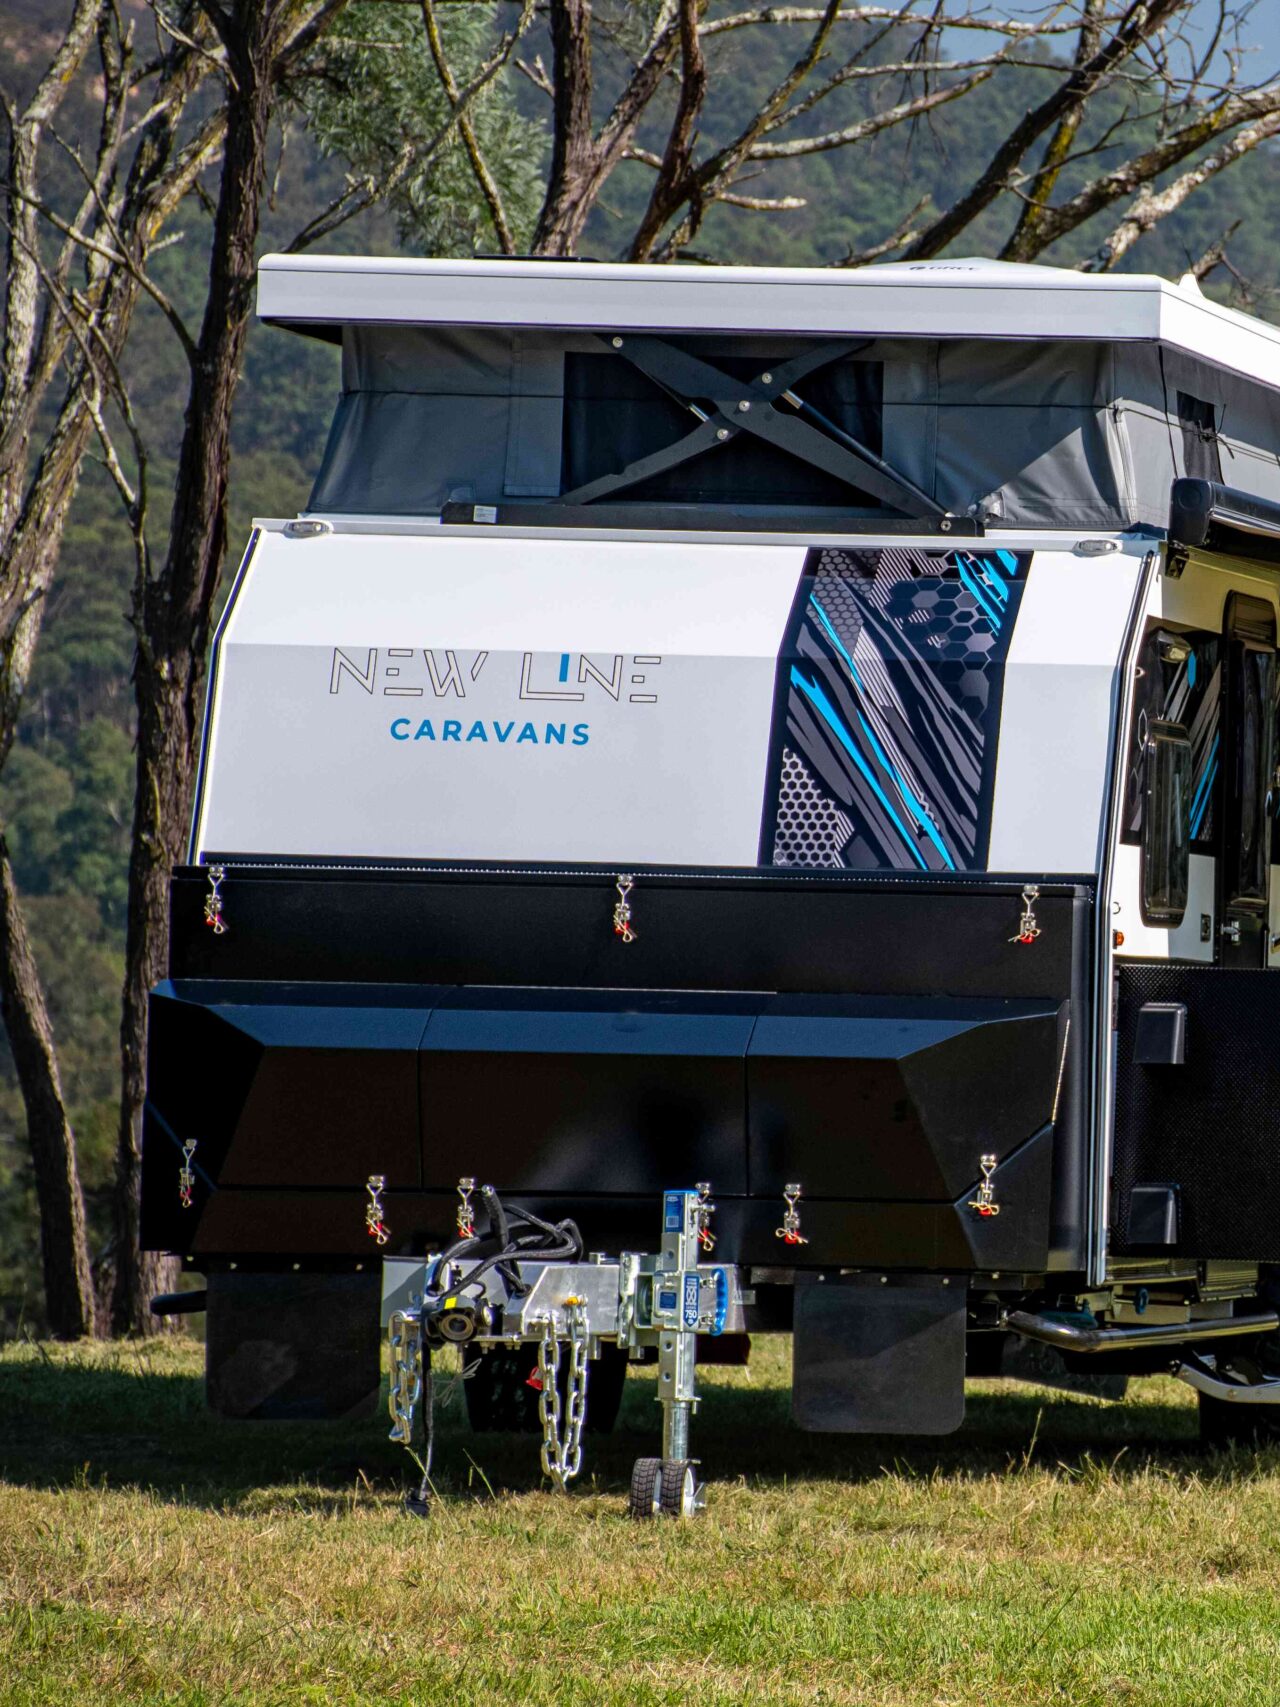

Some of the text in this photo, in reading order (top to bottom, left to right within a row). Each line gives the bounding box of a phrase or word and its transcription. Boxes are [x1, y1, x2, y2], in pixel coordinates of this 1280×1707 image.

[330, 647, 662, 703] NEW LINE
[389, 717, 590, 746] CARAVANS
[685, 1309, 697, 1319] 750
